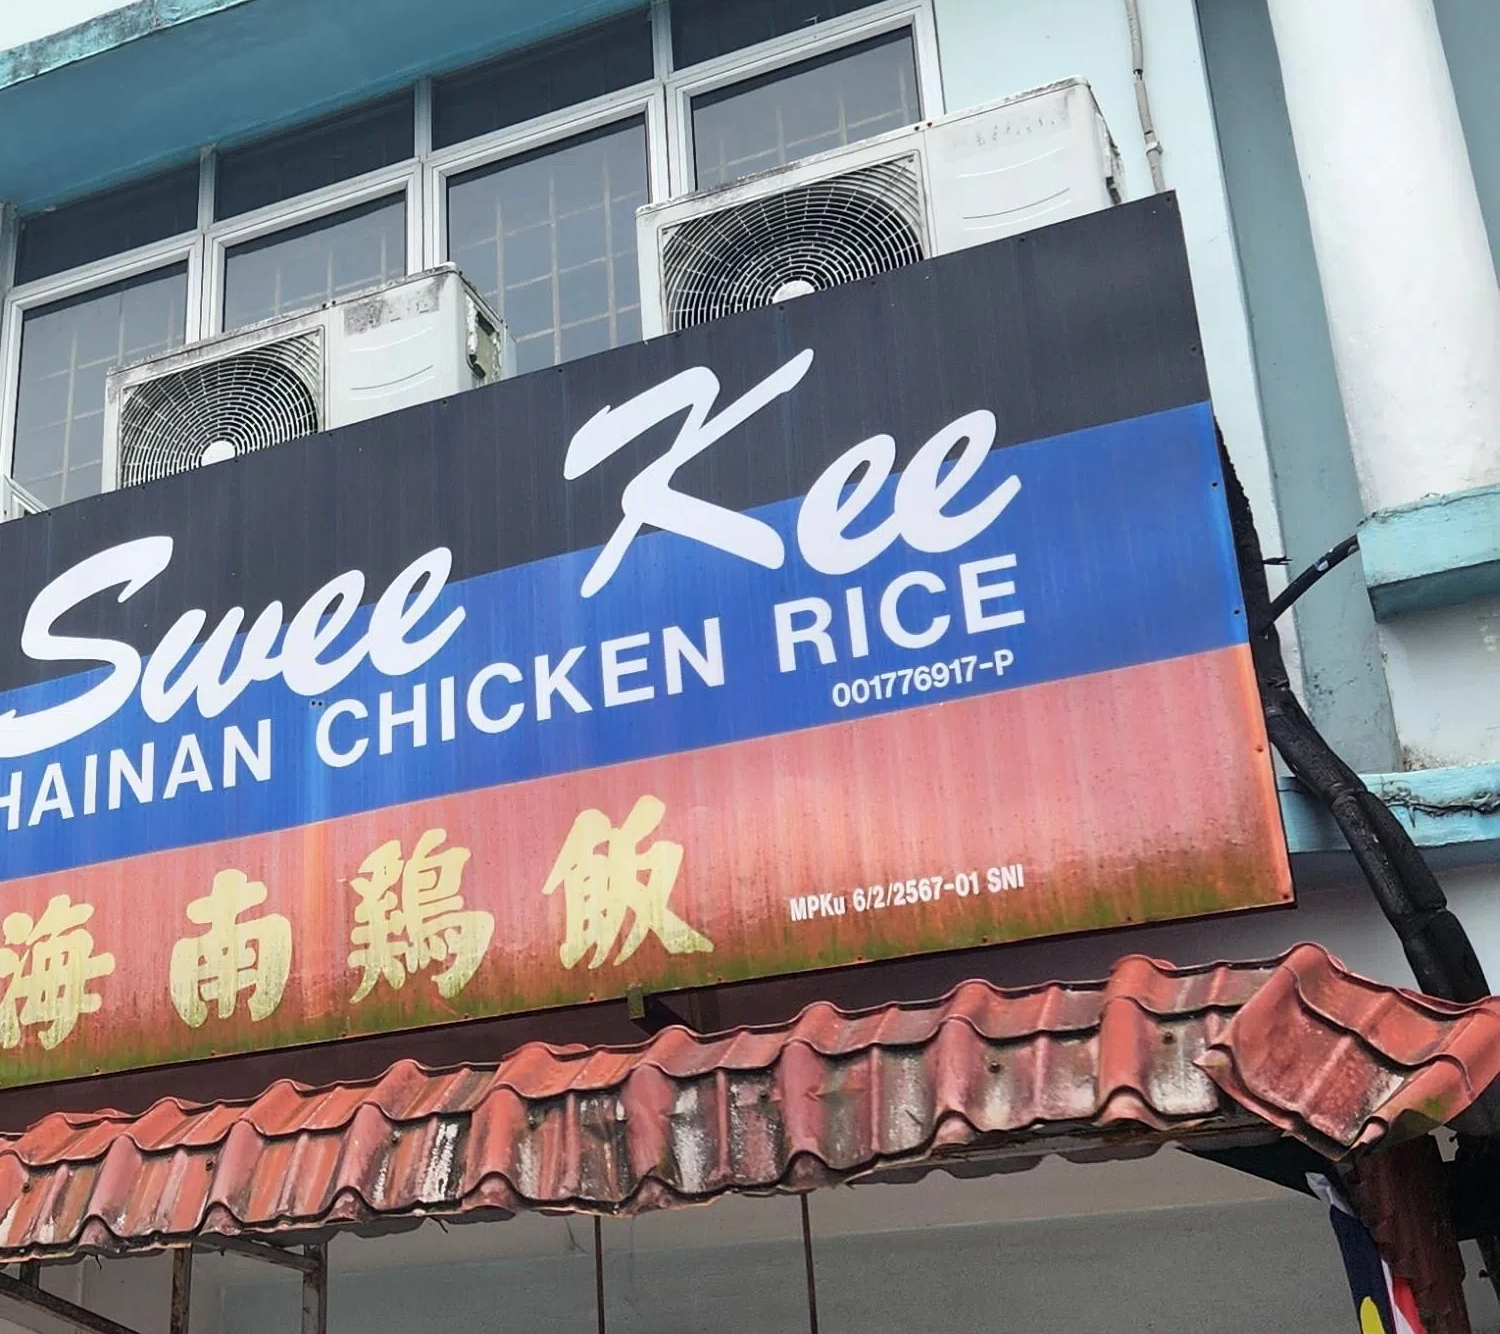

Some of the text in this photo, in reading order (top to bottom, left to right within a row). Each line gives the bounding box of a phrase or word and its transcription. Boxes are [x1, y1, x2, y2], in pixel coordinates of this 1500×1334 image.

[563, 348, 1022, 598] Kee
[314, 617, 725, 768] CHICKEN
[773, 553, 1026, 674] RICE
[831, 648, 1015, 709] 001776917-P
[788, 863, 1025, 923] MPKu 6/2/2567-01 SNI
